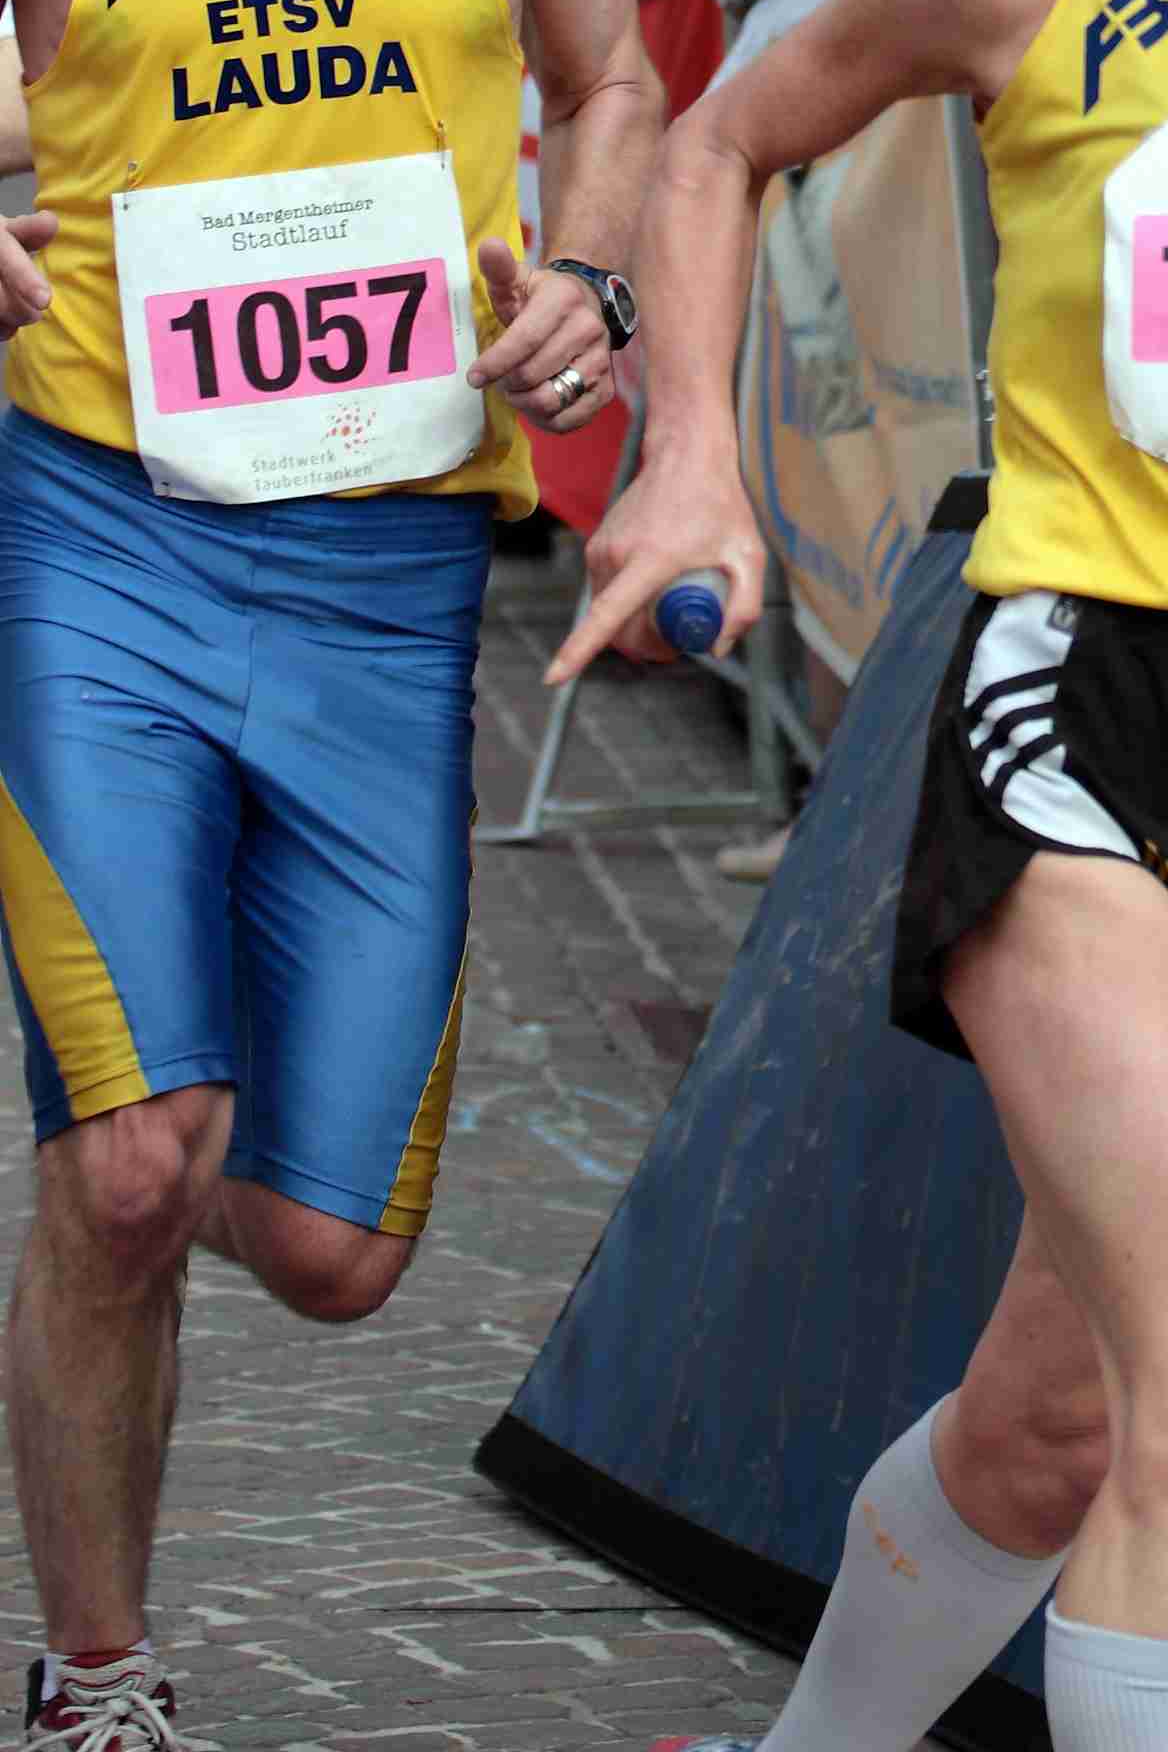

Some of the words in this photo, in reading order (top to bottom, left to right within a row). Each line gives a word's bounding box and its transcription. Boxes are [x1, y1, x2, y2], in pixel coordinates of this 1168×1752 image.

[171, 41, 418, 121] LAUDA
[201, 212, 235, 231] Bad
[239, 198, 375, 226] Mergentheimer
[231, 219, 349, 252] Stadtlauf
[170, 271, 427, 399] 1057
